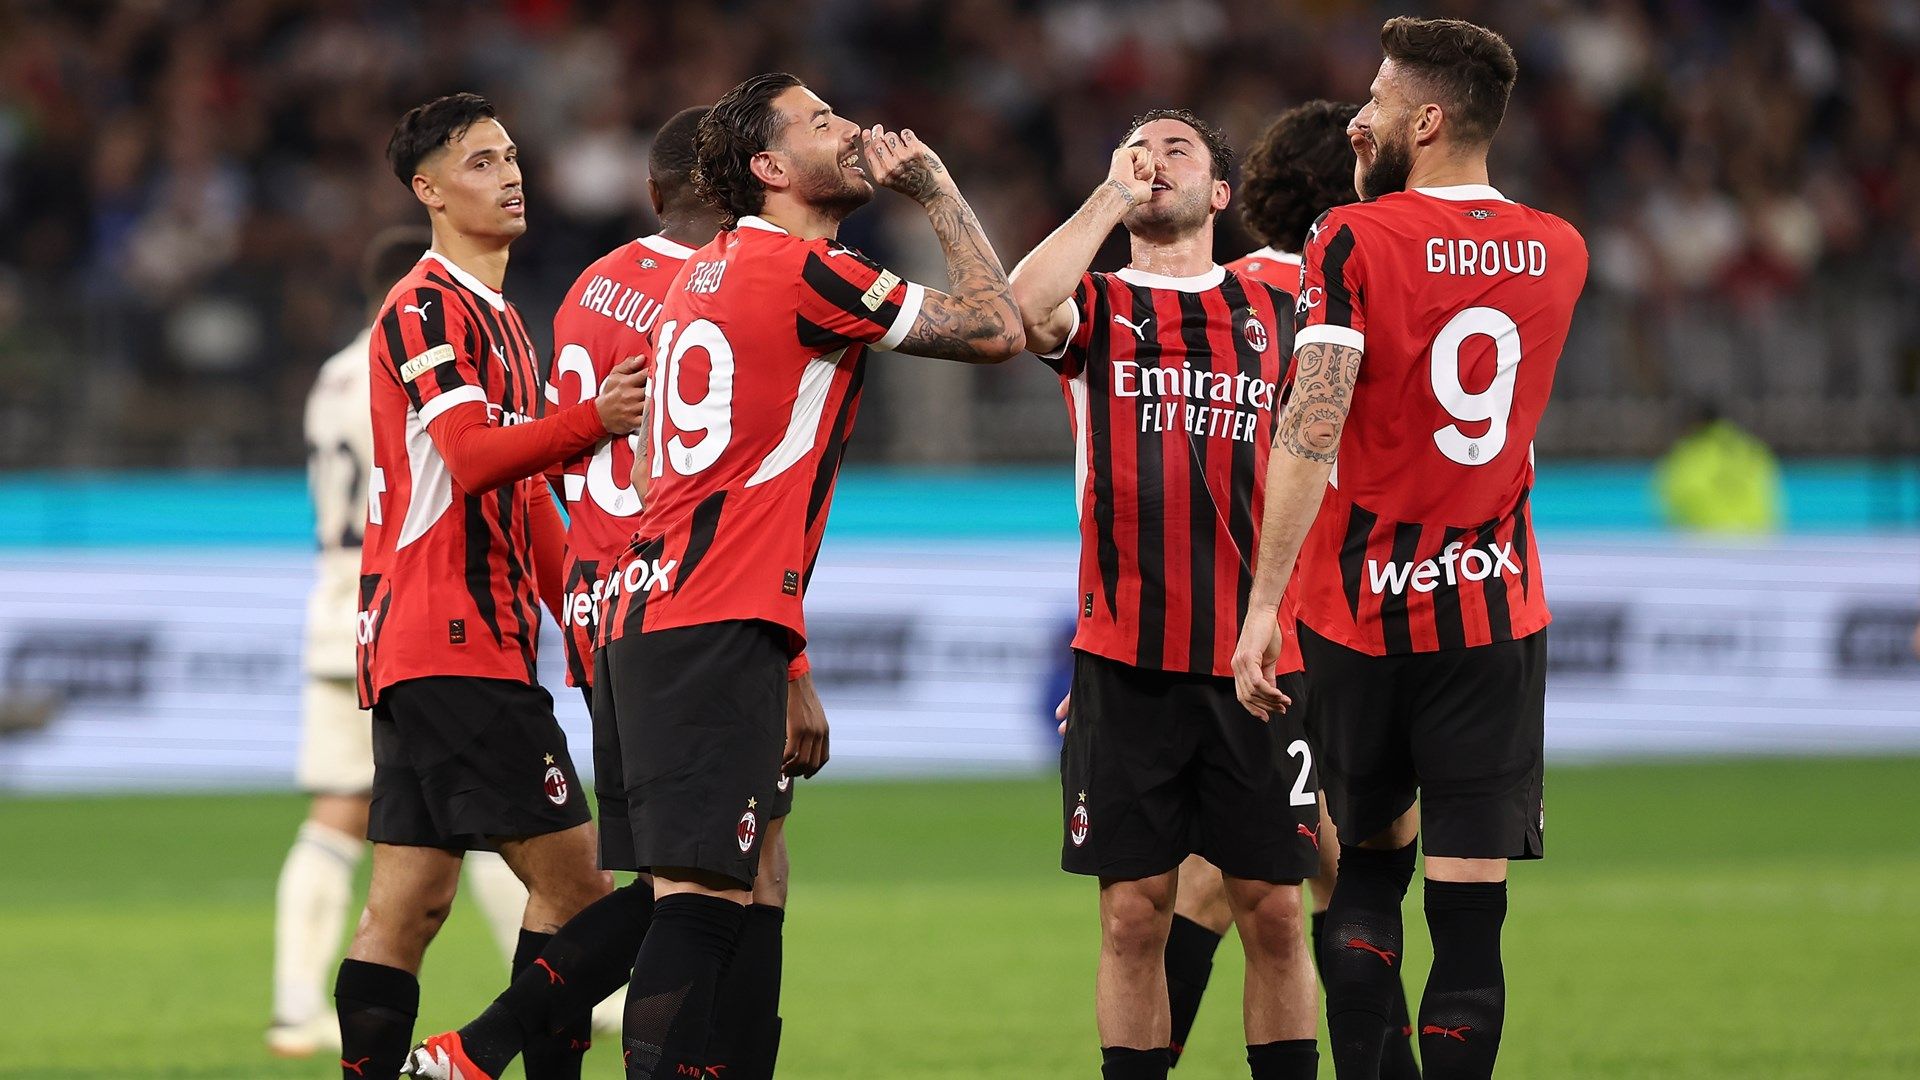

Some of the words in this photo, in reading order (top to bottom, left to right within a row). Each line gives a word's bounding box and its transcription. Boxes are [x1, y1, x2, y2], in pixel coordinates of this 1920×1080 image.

[685, 259, 727, 294] THEO
[1426, 237, 1547, 277] GIROUD
[579, 275, 664, 333] KALULU
[651, 318, 735, 478] 19
[1112, 360, 1276, 412] Emirates
[1430, 305, 1522, 466] 9
[1141, 402, 1179, 433] FLY
[1185, 403, 1258, 443] BETTER
[1368, 541, 1521, 595] wefox
[1286, 739, 1316, 806] 2
